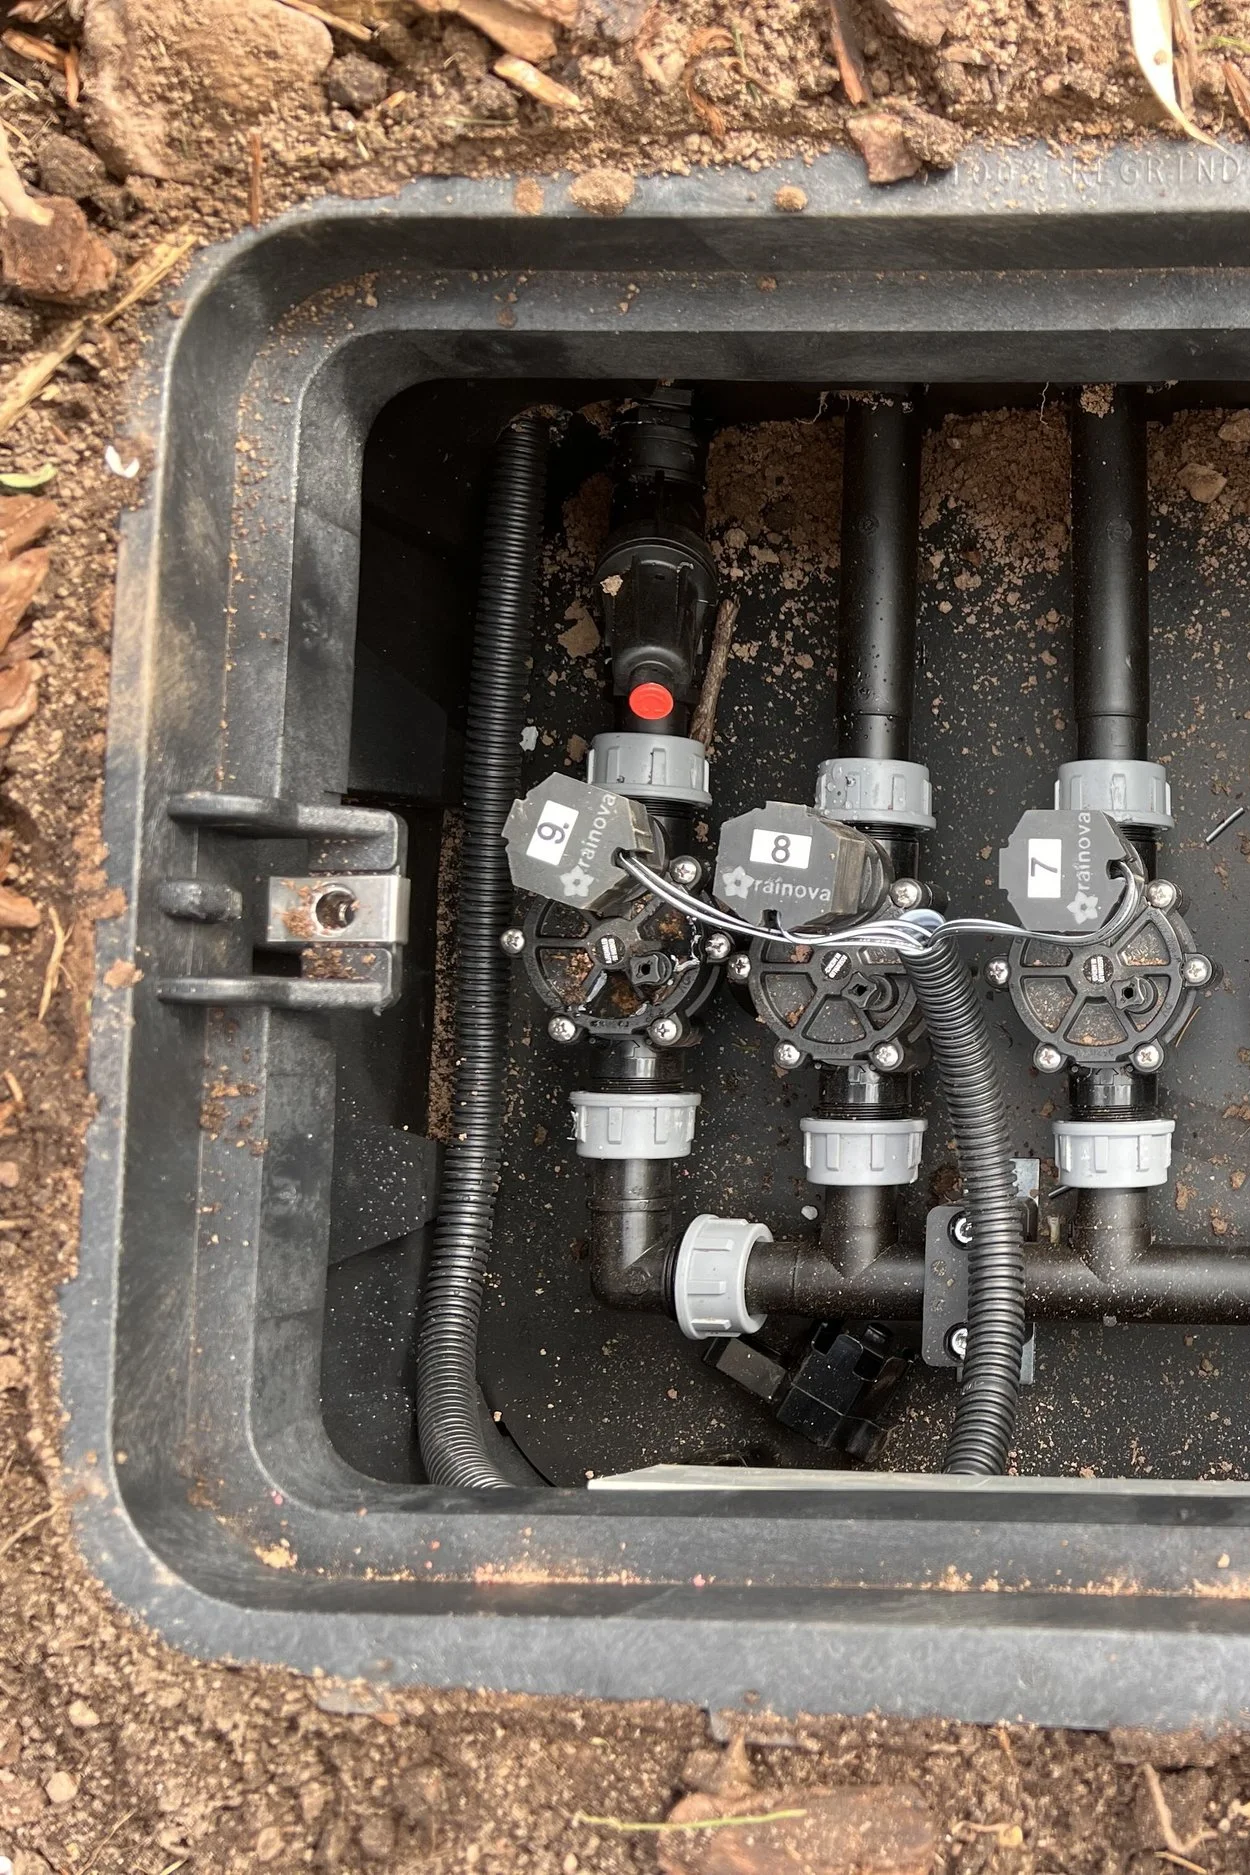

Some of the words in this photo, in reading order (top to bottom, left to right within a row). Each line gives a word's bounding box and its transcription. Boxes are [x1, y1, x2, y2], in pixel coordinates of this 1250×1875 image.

[578, 793, 617, 869] rainova
[771, 834, 791, 863] 8
[1075, 812, 1091, 891] rainova
[1031, 857, 1058, 877] 7
[753, 876, 831, 901] rainova
